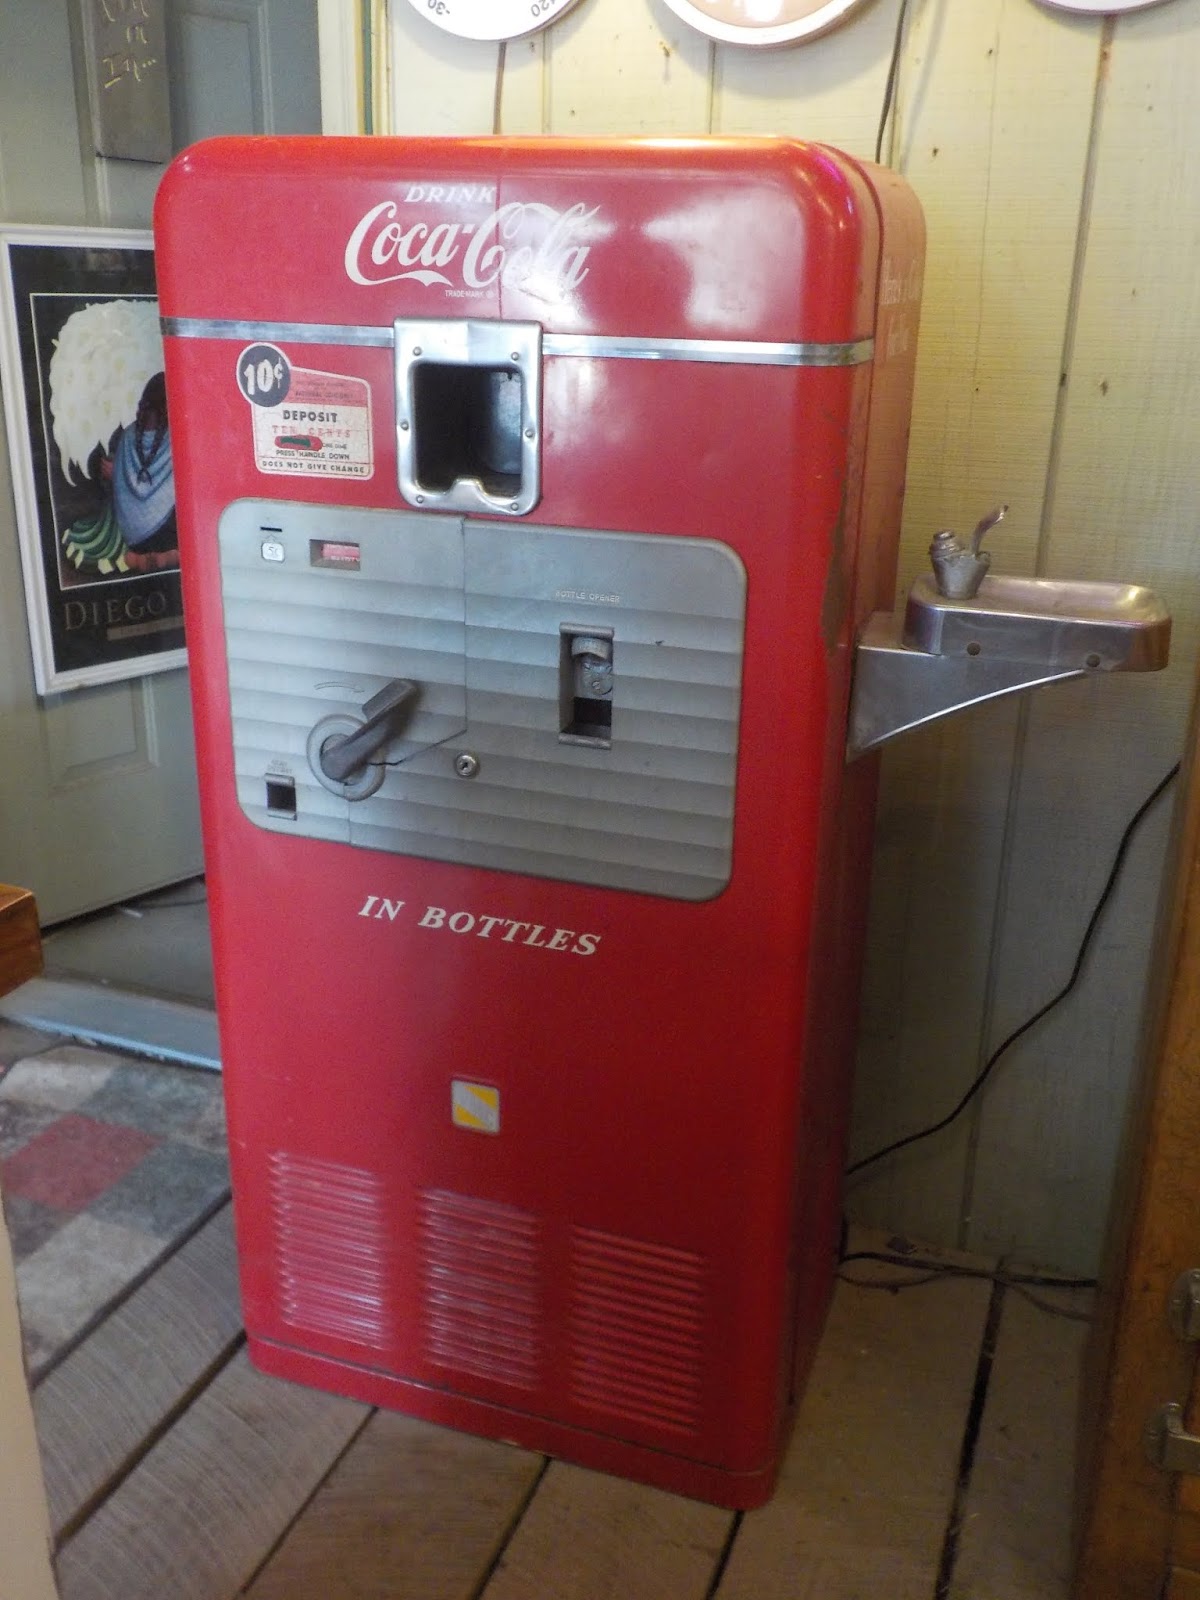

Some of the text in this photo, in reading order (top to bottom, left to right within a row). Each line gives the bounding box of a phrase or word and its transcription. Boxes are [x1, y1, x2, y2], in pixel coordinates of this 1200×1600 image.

[404, 186, 498, 203] DRINK
[345, 201, 601, 289] Coca-Cola
[282, 410, 338, 423] DEPOSIT
[271, 424, 351, 438] TEN CENTS
[276, 449, 350, 460] PRESS HANDLE DOWN
[262, 460, 365, 474] DOES NOT GIVE CHANGE
[64, 592, 167, 631] DIEGO
[358, 895, 602, 956] IN BOTTLES
